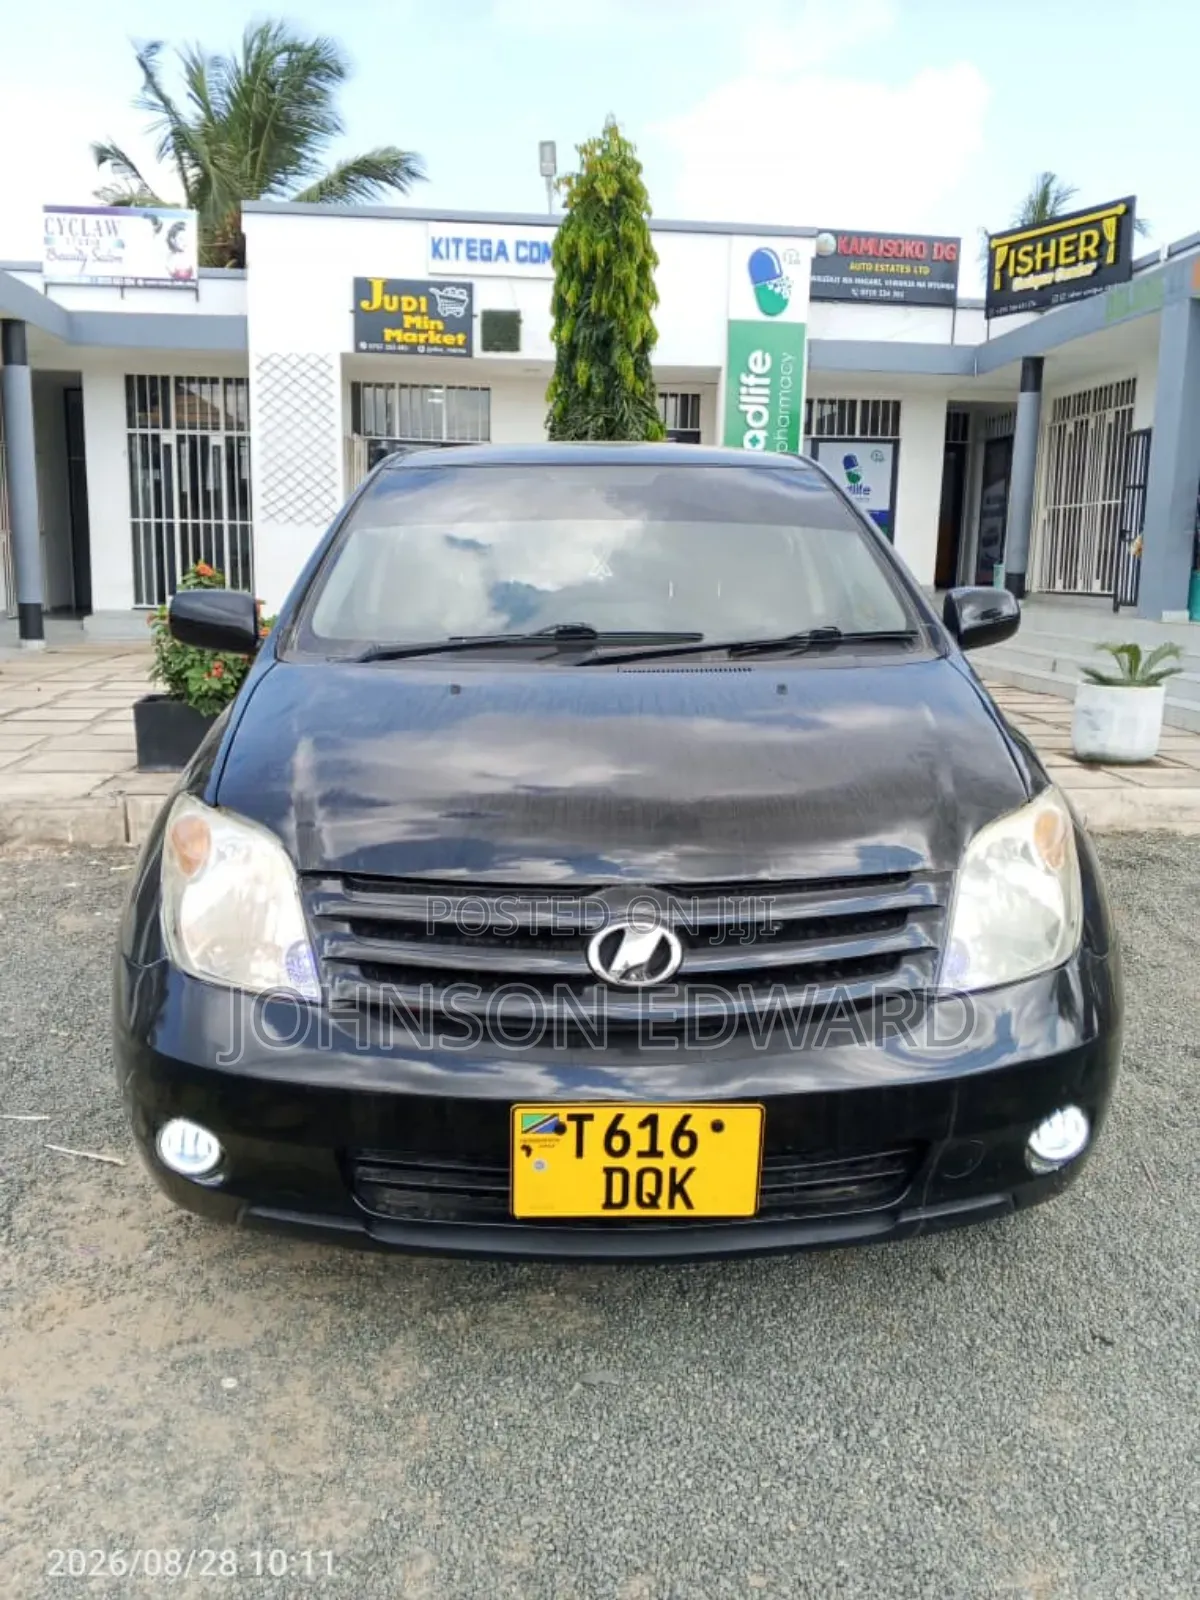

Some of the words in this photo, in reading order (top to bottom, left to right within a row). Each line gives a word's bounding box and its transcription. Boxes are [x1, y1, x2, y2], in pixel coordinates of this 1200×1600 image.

[44, 217, 121, 237] CYCLAW
[431, 236, 509, 262] KITEGA
[837, 236, 927, 259] KAMUSOKO
[932, 242, 957, 260] DG
[850, 262, 873, 272] AUTO
[913, 265, 931, 275] LTD
[402, 314, 445, 331] Min
[383, 328, 466, 346] Market
[566, 1113, 594, 1159] T
[603, 1113, 699, 1159] 616
[601, 1166, 697, 1210] DQK
